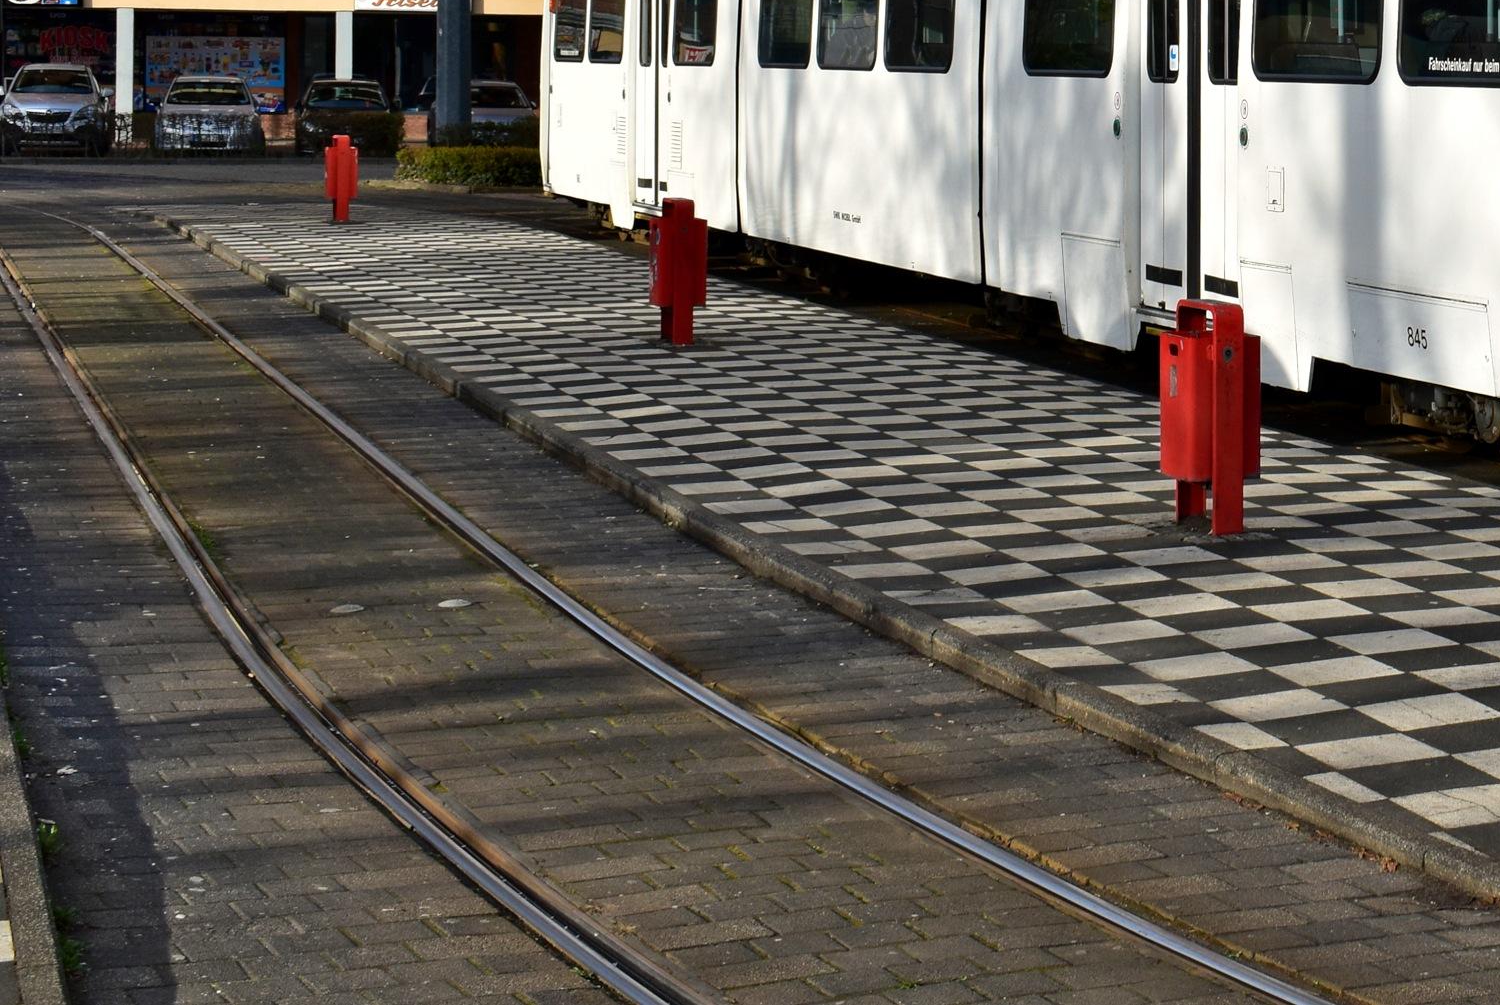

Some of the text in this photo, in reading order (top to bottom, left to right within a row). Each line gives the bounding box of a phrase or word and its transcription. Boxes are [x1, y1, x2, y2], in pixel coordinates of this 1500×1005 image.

[40, 25, 109, 52] KIOSK
[1428, 57, 1472, 72] Fahrscheinkauf
[1472, 61, 1483, 72] nur
[1484, 58, 1500, 73] beim
[1407, 326, 1428, 350] 845
